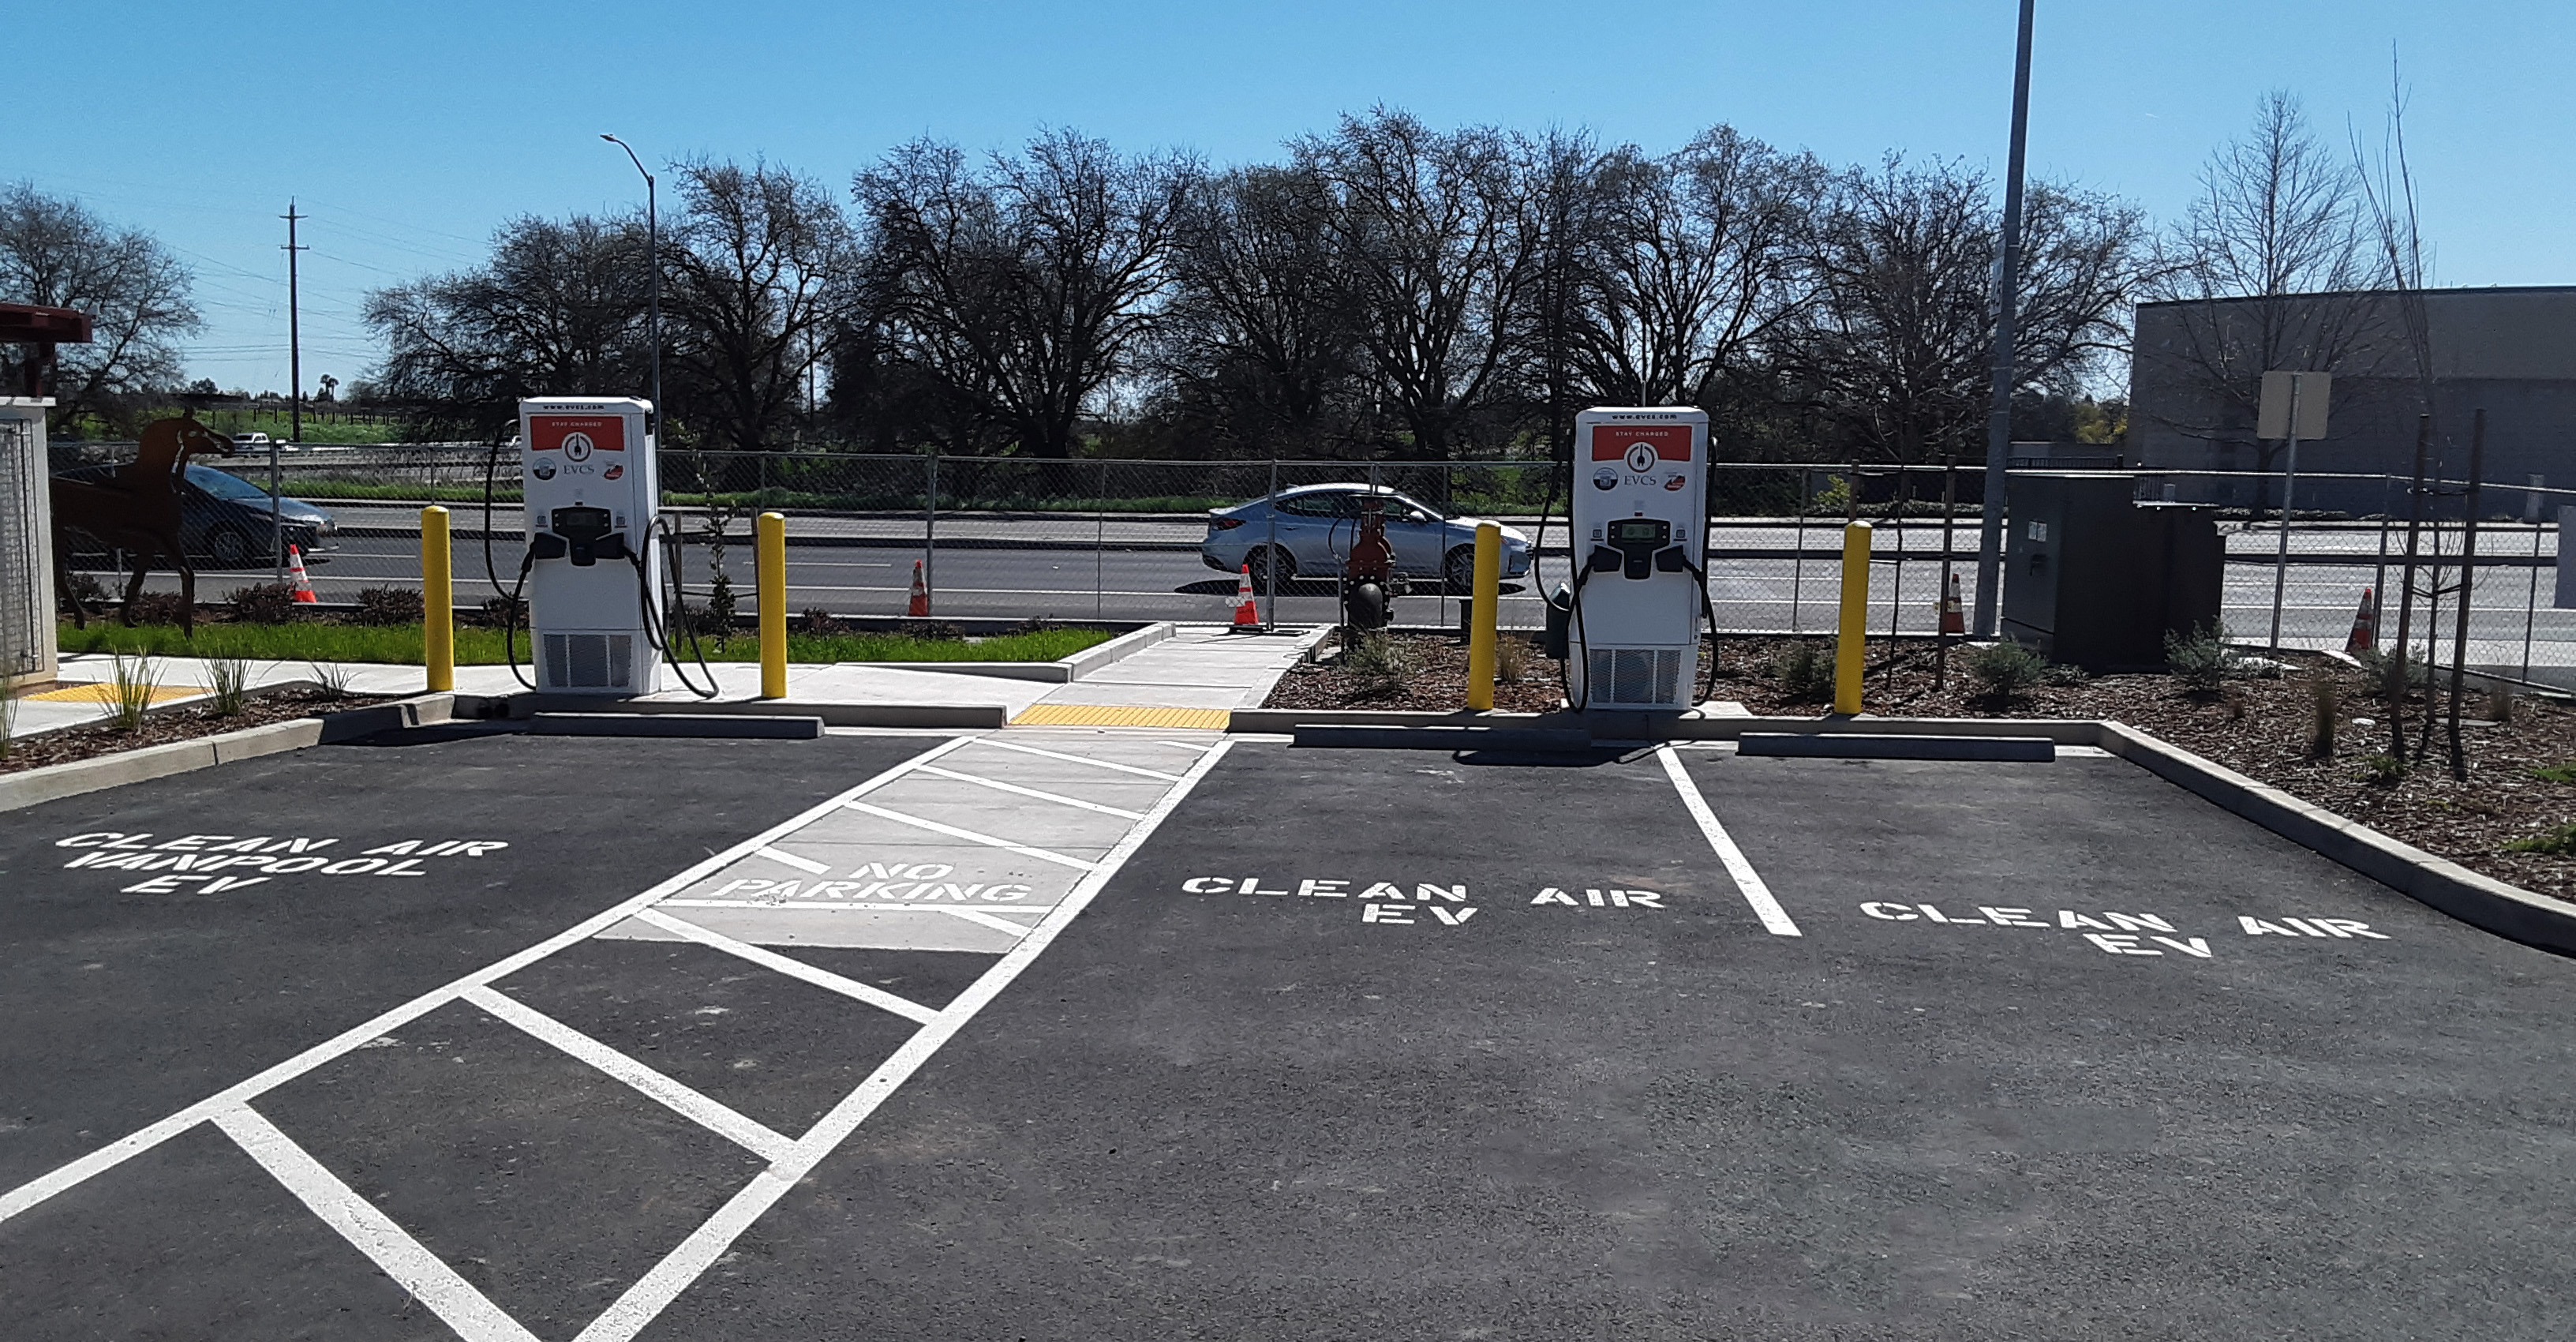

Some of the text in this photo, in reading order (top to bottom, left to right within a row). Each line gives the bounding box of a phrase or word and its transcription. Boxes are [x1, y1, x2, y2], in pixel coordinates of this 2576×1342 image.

[564, 465, 595, 474] EVCS
[1624, 475, 1657, 485] EVCS
[55, 833, 509, 857] CLEAN AIR
[63, 851, 426, 876] VANPOOL
[848, 862, 954, 880] NO
[120, 875, 274, 894] EV
[708, 878, 1032, 902] PARKING
[1181, 877, 1665, 908] CLEAN AIR
[1361, 903, 1478, 925] EV
[1859, 902, 2392, 939] CLEAN AIR
[2083, 933, 2212, 958] EV
